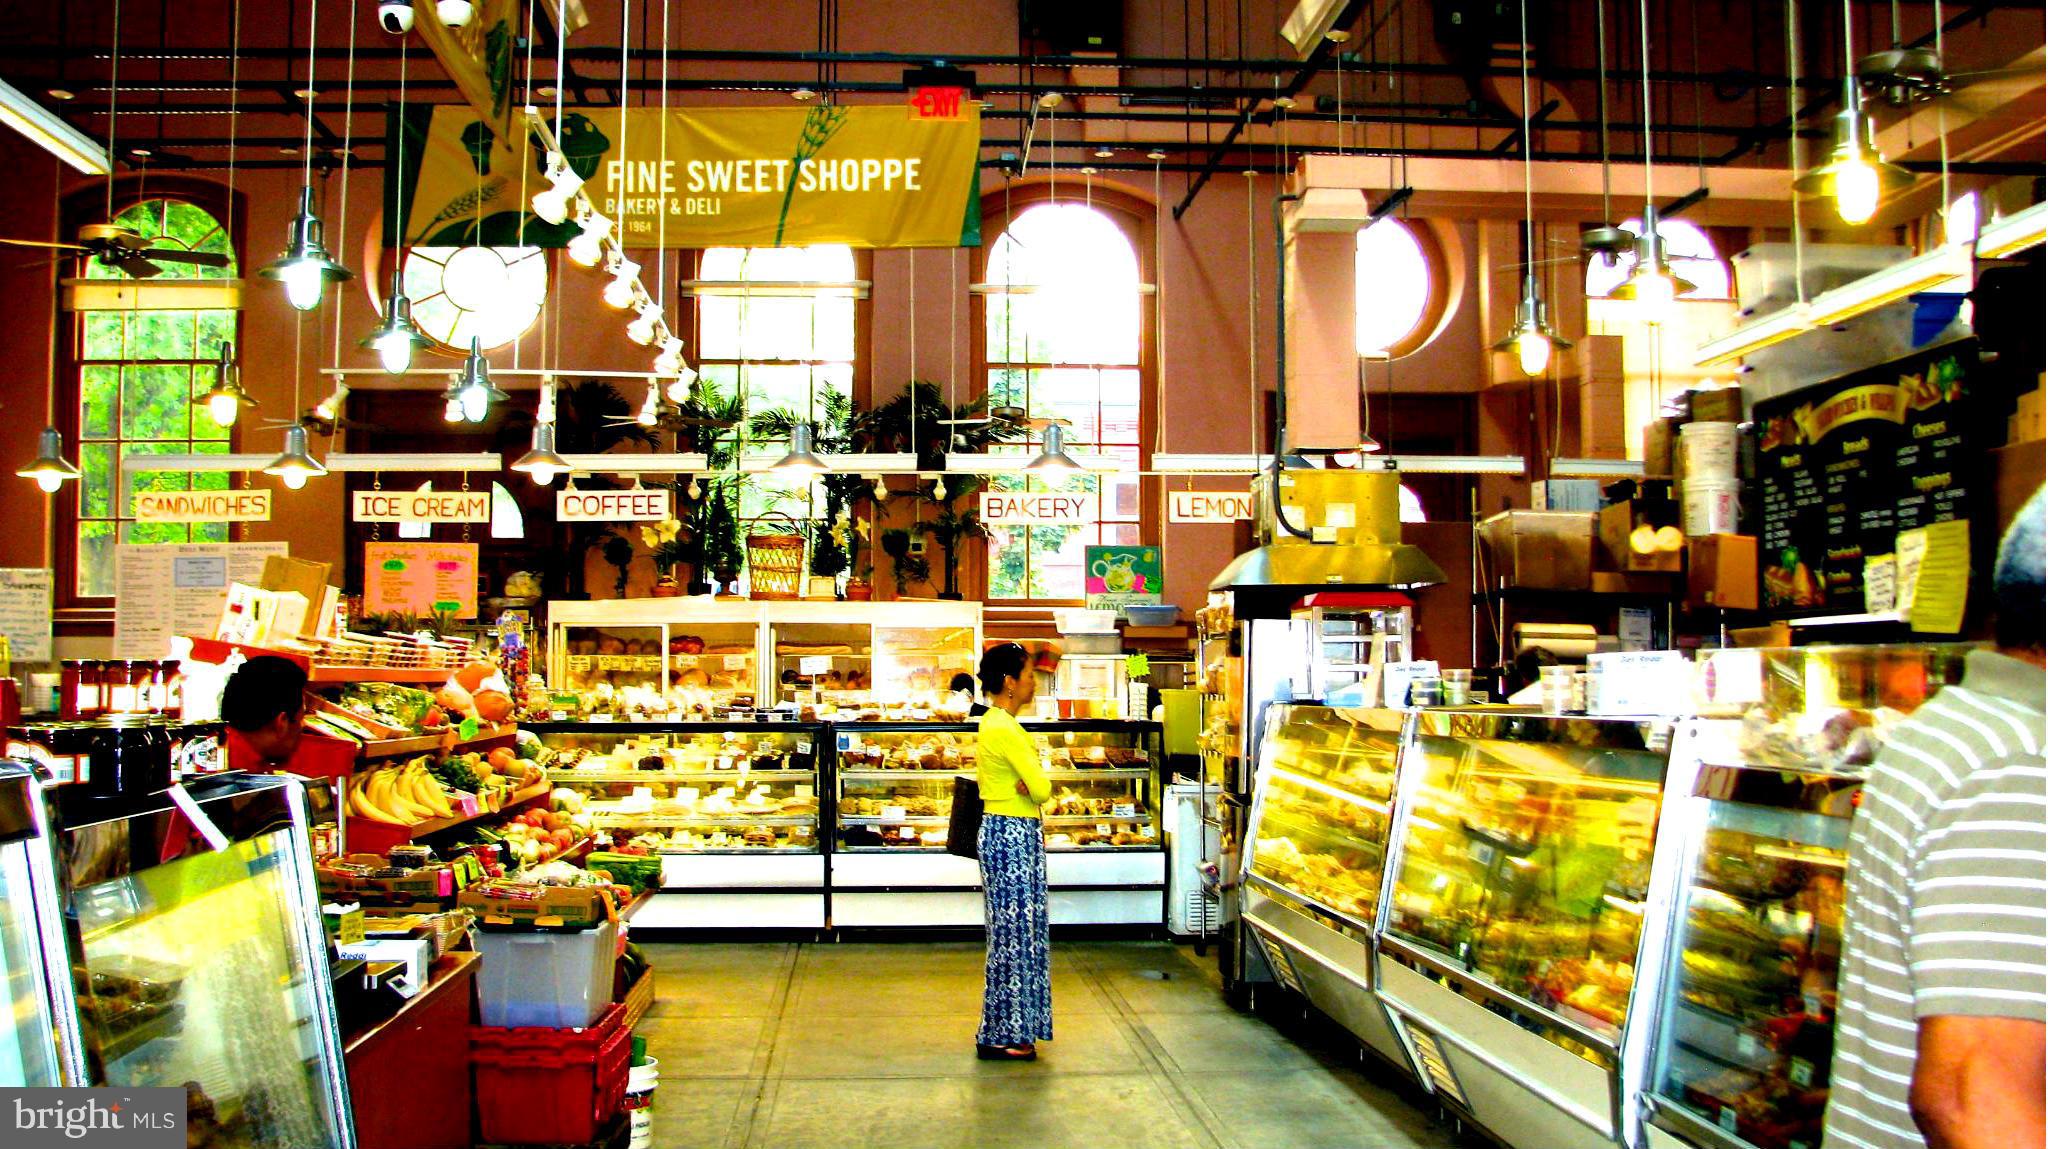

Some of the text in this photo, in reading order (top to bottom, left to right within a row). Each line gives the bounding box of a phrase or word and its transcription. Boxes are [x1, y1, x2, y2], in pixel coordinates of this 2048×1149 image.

[917, 86, 963, 117] EXIT
[606, 158, 921, 193] FINE SWEET SHOPPE
[670, 199, 681, 215] &
[686, 198, 721, 215] DELI
[629, 221, 651, 232] 1964
[141, 495, 267, 517] SANDWICHES
[361, 497, 485, 517] ICE CREAM
[564, 495, 662, 516] COFFEE
[987, 498, 1085, 518] BAKERY
[1177, 496, 1251, 518] LEMON
